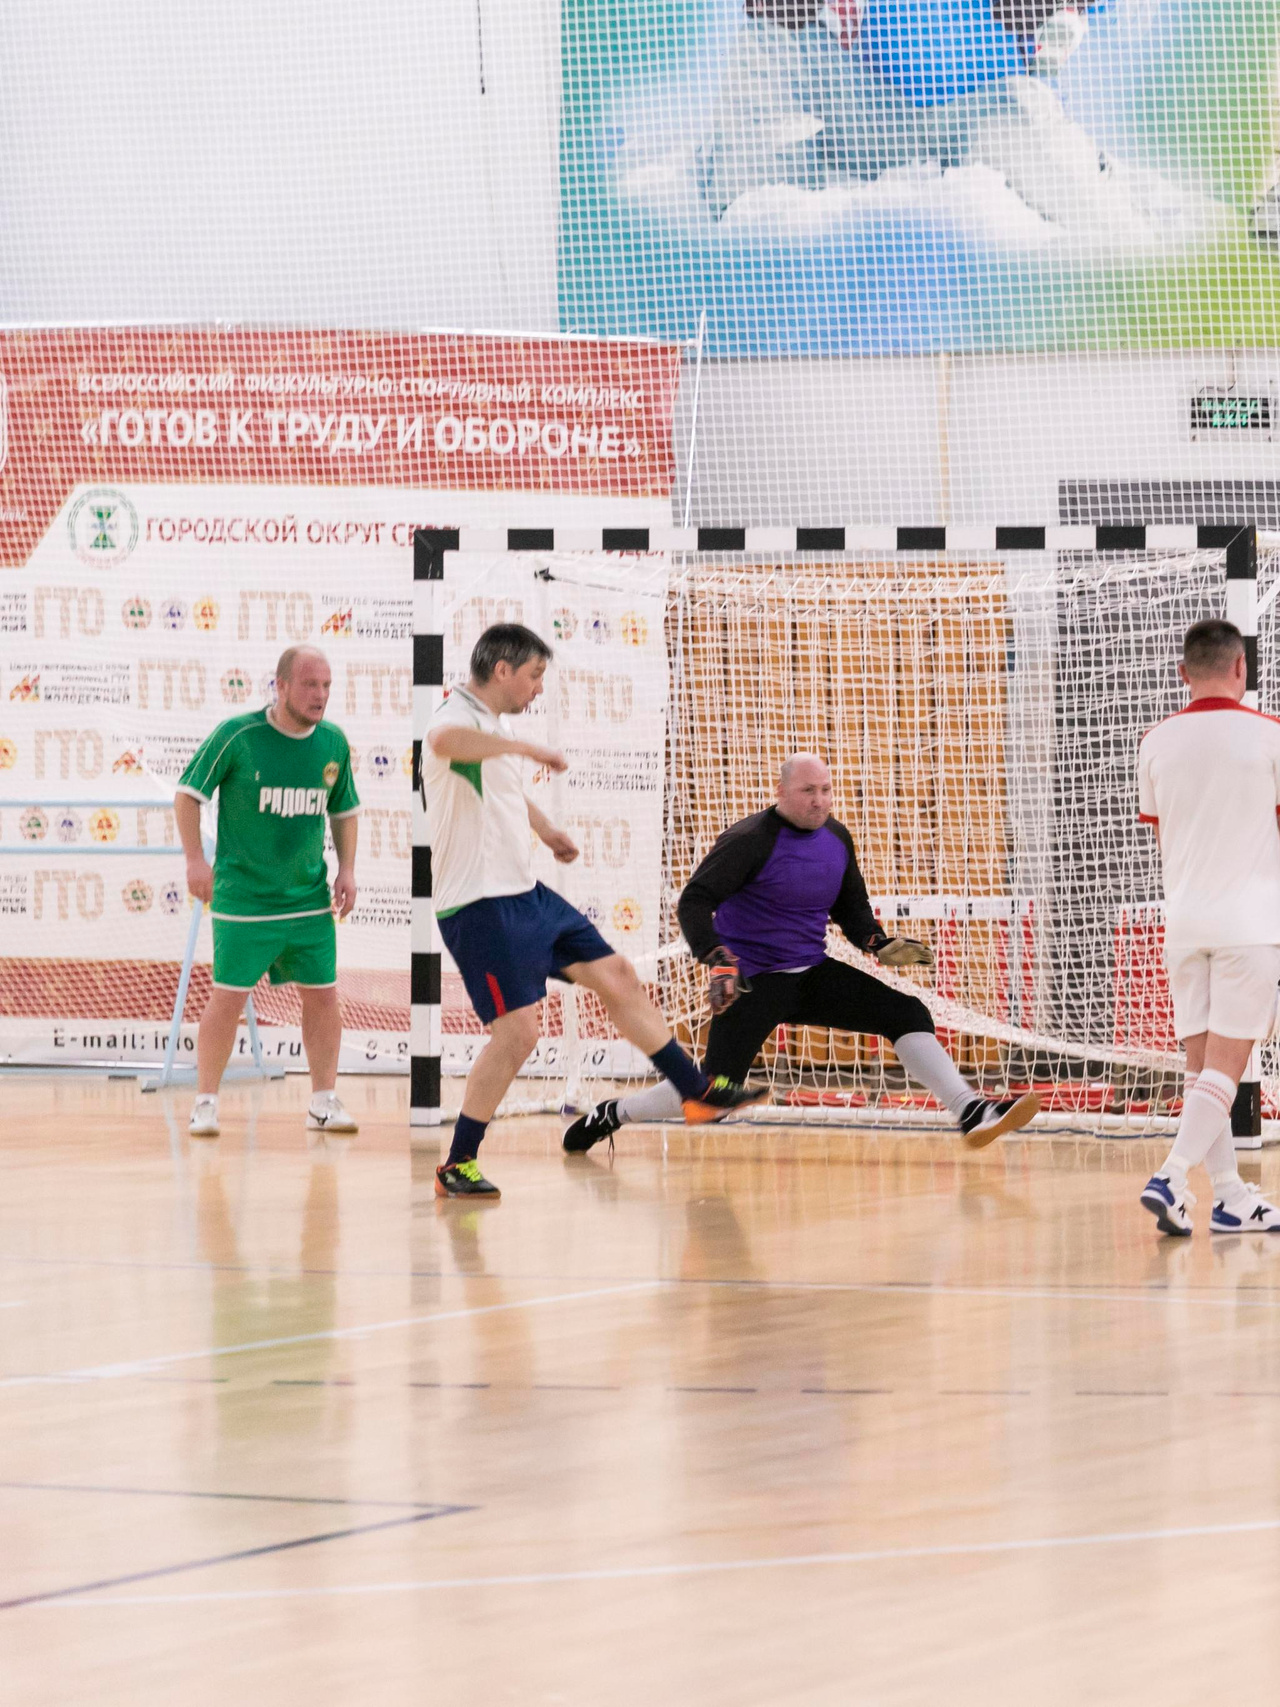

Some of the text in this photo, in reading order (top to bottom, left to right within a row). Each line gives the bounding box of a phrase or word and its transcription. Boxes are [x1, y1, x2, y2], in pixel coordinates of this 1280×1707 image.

[78, 370, 645, 409] ВСЕРОССИЙСКИЙ ФИЗКУЛЬТУРНО-СПОРТИВНЫЙ КОМПЛЕКС
[80, 409, 642, 458] «ГОТОВ К ТРУДУ И ОБОРОНЕ»
[146, 514, 299, 545] ГОРОДСКОЙ
[306, 520, 386, 545] ОКРУГ
[34, 586, 105, 640] ГТО
[237, 589, 314, 642] ГТО
[137, 659, 207, 712] ГТО
[34, 730, 104, 780] ГТО
[33, 870, 104, 920] ГТО
[54, 1028, 146, 1050] E-mail:
